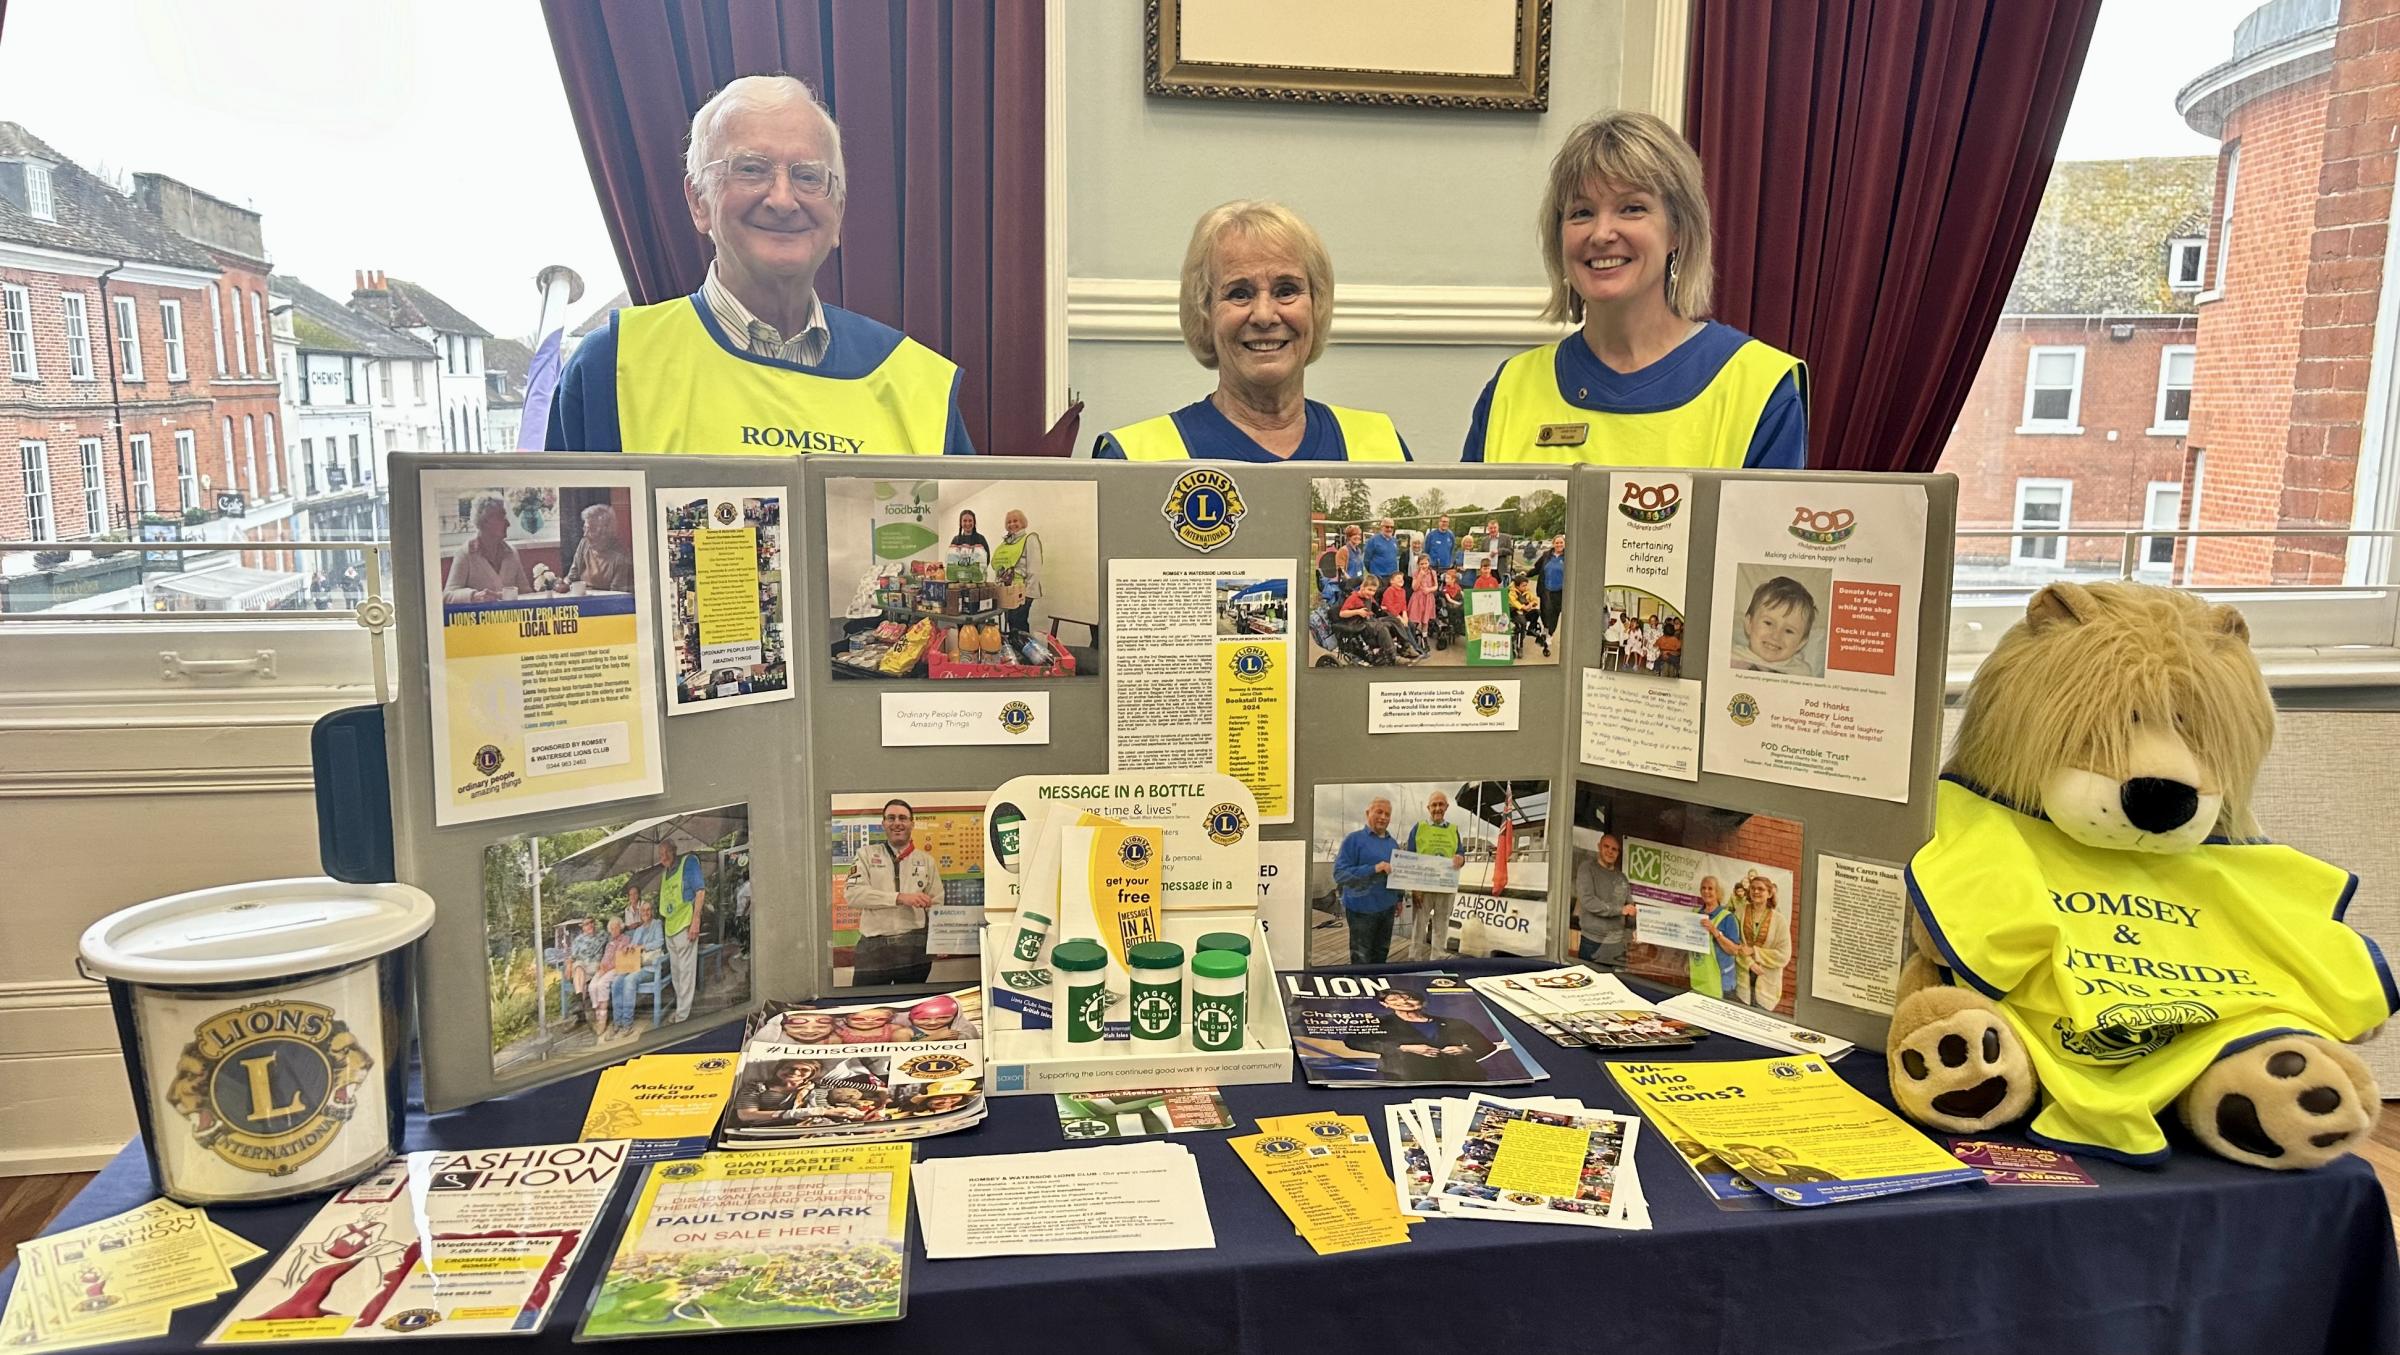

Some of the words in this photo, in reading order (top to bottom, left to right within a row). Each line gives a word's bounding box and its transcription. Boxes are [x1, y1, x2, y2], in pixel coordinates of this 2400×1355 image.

[312, 372, 342, 384] CHEMIST
[741, 426, 864, 454] ROMSEY
[1182, 473, 1228, 490] LIONS
[1622, 482, 1679, 509] POD
[885, 503, 931, 515] foodbank
[1197, 495, 1217, 520] L
[1792, 507, 1854, 531] POD
[1183, 528, 1228, 542] INTERNATIONAL
[1622, 539, 1673, 553] Entertaining
[1630, 552, 1663, 562] children
[1765, 552, 1787, 560] Making
[1789, 552, 1816, 560] children
[1817, 554, 1836, 562] happy
[1627, 565, 1633, 573] in
[1636, 565, 1669, 576] hospital
[1839, 587, 1864, 595] Donate
[449, 612, 477, 627] LIONS
[479, 608, 534, 624] COMMUNITY
[537, 605, 579, 621] PROJECTS
[519, 622, 551, 638] LOCAL
[553, 619, 578, 634] NEED
[1836, 627, 1857, 635] Check
[1805, 699, 1820, 707] Pod
[1822, 701, 1850, 712] thanks
[897, 711, 929, 719] Ordinary
[960, 710, 982, 719] Doing
[1799, 709, 1829, 721] Romsey
[1833, 713, 1854, 722] Lions
[910, 721, 943, 729] Amazing
[946, 720, 969, 728] Things
[532, 742, 571, 753] SPONSORED
[581, 738, 607, 747] ROMSEY
[1761, 741, 1778, 751] POD
[1781, 745, 1822, 758] Charitable
[1826, 751, 1850, 761] Trust
[537, 752, 572, 762] WATERSIDE
[573, 749, 592, 757] LIONS
[457, 778, 488, 794] ordinary
[490, 770, 515, 786] people
[471, 785, 500, 798] amazing
[501, 777, 521, 791] things
[1038, 784, 1110, 799] MESSAGE
[1114, 785, 1130, 798] IN
[1134, 784, 1145, 797] A
[1150, 783, 1205, 798] BOTTLE
[1104, 806, 1129, 815] time
[1134, 804, 1142, 814] &
[1212, 803, 1239, 814] LIONS
[1220, 816, 1232, 831] L
[1663, 851, 1700, 869] Romsey
[1663, 863, 1694, 880] Young
[1106, 877, 1124, 888] get
[1126, 878, 1149, 887] your
[1161, 880, 1208, 892] message
[1212, 878, 1223, 890] in
[1226, 880, 1233, 889] a
[1663, 877, 1692, 890] Carers
[1117, 887, 1151, 904] free
[1456, 895, 1508, 914] ALISON
[2048, 888, 2201, 929] ROMSEY
[1120, 907, 1150, 922] MESSAGE
[1123, 917, 1139, 935] IN
[1143, 915, 1152, 933] A
[1125, 934, 1154, 948] BOTTLE
[2112, 924, 2141, 945] &
[1285, 975, 1391, 998] LION
[1024, 999, 1038, 1007] Clubs
[1133, 990, 1179, 1017] EMERGENCY
[1022, 1006, 1040, 1016] British
[1193, 1000, 1238, 1030] EMERGENCY
[1302, 1011, 1374, 1019] Changing
[206, 1008, 328, 1050] LIONS
[766, 1043, 967, 1055] #LionsGetInvolved
[1039, 1070, 1080, 1080] Supporting
[1082, 1070, 1093, 1078] the
[1096, 1069, 1113, 1077] Lions
[1115, 1068, 1153, 1076] continued
[1155, 1066, 1175, 1075] good
[1177, 1064, 1194, 1073] work
[1196, 1064, 1202, 1072] in
[1221, 1063, 1240, 1071] local
[1241, 1062, 1282, 1070] community
[1620, 1065, 1674, 1073] Wh
[240, 1050, 306, 1121] L
[1632, 1073, 1688, 1086] Who
[1646, 1086, 1747, 1103] Lions?
[1668, 1084, 1696, 1092] are
[215, 1119, 336, 1160] INTERNATIONA
[429, 1144, 625, 1171] FASHION
[736, 1149, 818, 1160] WATERSIDE
[823, 1146, 866, 1155] LIONS
[867, 1144, 904, 1152] CLUB
[723, 1158, 778, 1169] GIANT
[783, 1155, 854, 1166] EASTER
[726, 1167, 765, 1176] EGG
[770, 1164, 841, 1174] RAFFLE
[723, 1186, 761, 1194] HELP
[762, 1184, 778, 1192] US
[783, 1182, 826, 1191] SEND
[671, 1190, 795, 1204] DISADVANTAGED
[655, 1209, 795, 1228] PAULTONS
[802, 1206, 873, 1218] PARK
[673, 1232, 712, 1244] ON
[715, 1228, 772, 1239] SALE
[779, 1225, 842, 1237] HERE
[436, 1240, 505, 1248] Wednesday
